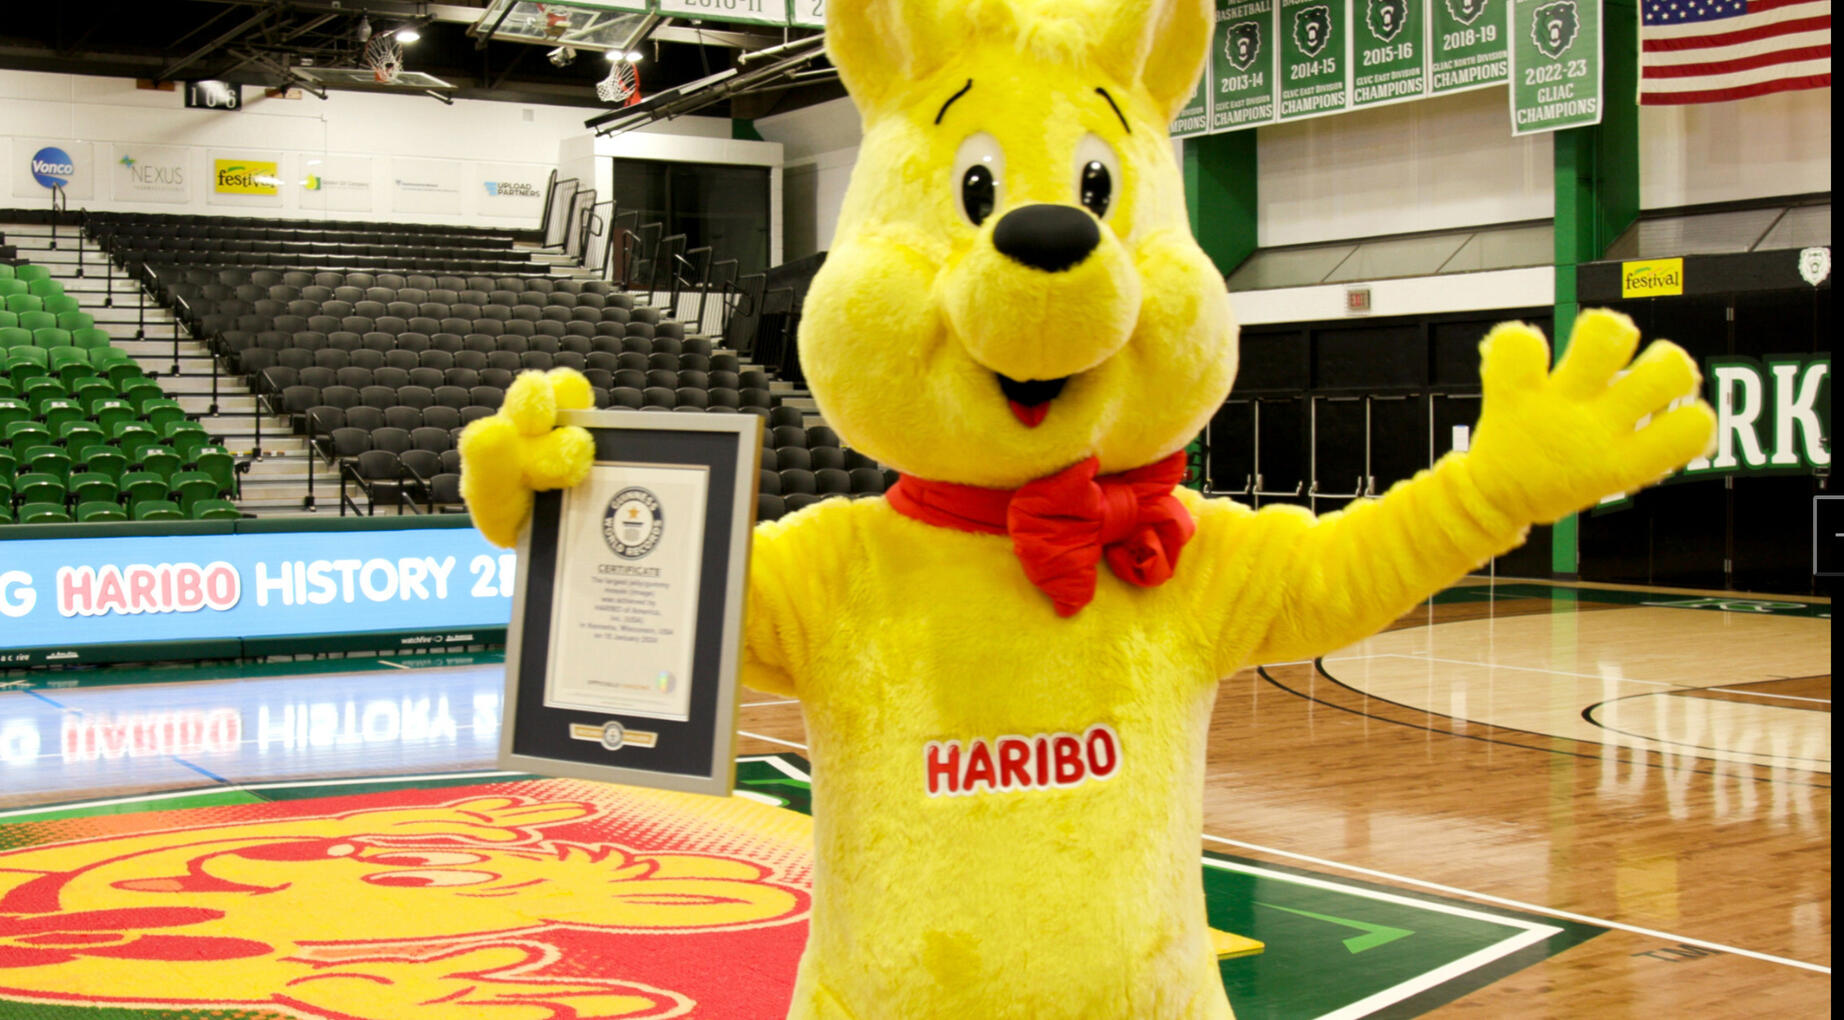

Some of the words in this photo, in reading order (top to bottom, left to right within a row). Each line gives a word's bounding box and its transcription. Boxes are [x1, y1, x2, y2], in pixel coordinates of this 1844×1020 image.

[1443, 25, 1496, 50] 2018-19
[1363, 42, 1413, 66] 2015-16
[1290, 58, 1336, 80] 2014-15
[1433, 61, 1508, 89] CHAMPIONS
[1525, 59, 1587, 85] 2022-23
[1221, 72, 1264, 93] 2013-14
[1354, 78, 1424, 102] CHAMPIONS
[1537, 83, 1574, 104] GLIAC
[191, 86, 237, 109] 106
[1281, 91, 1346, 115] CHAMPIONS
[1214, 104, 1273, 126] CHAMPIONS
[1517, 97, 1596, 125] CHAMPIONS
[33, 160, 73, 174] Vonco
[131, 165, 183, 185] NEXUS
[497, 182, 532, 190] UPLOAD
[497, 189, 541, 198] PARTNERS
[1625, 270, 1681, 290] festival
[60, 564, 238, 614] HARIBO
[255, 556, 456, 606] HISTORY
[926, 727, 1118, 795] HARIBO
